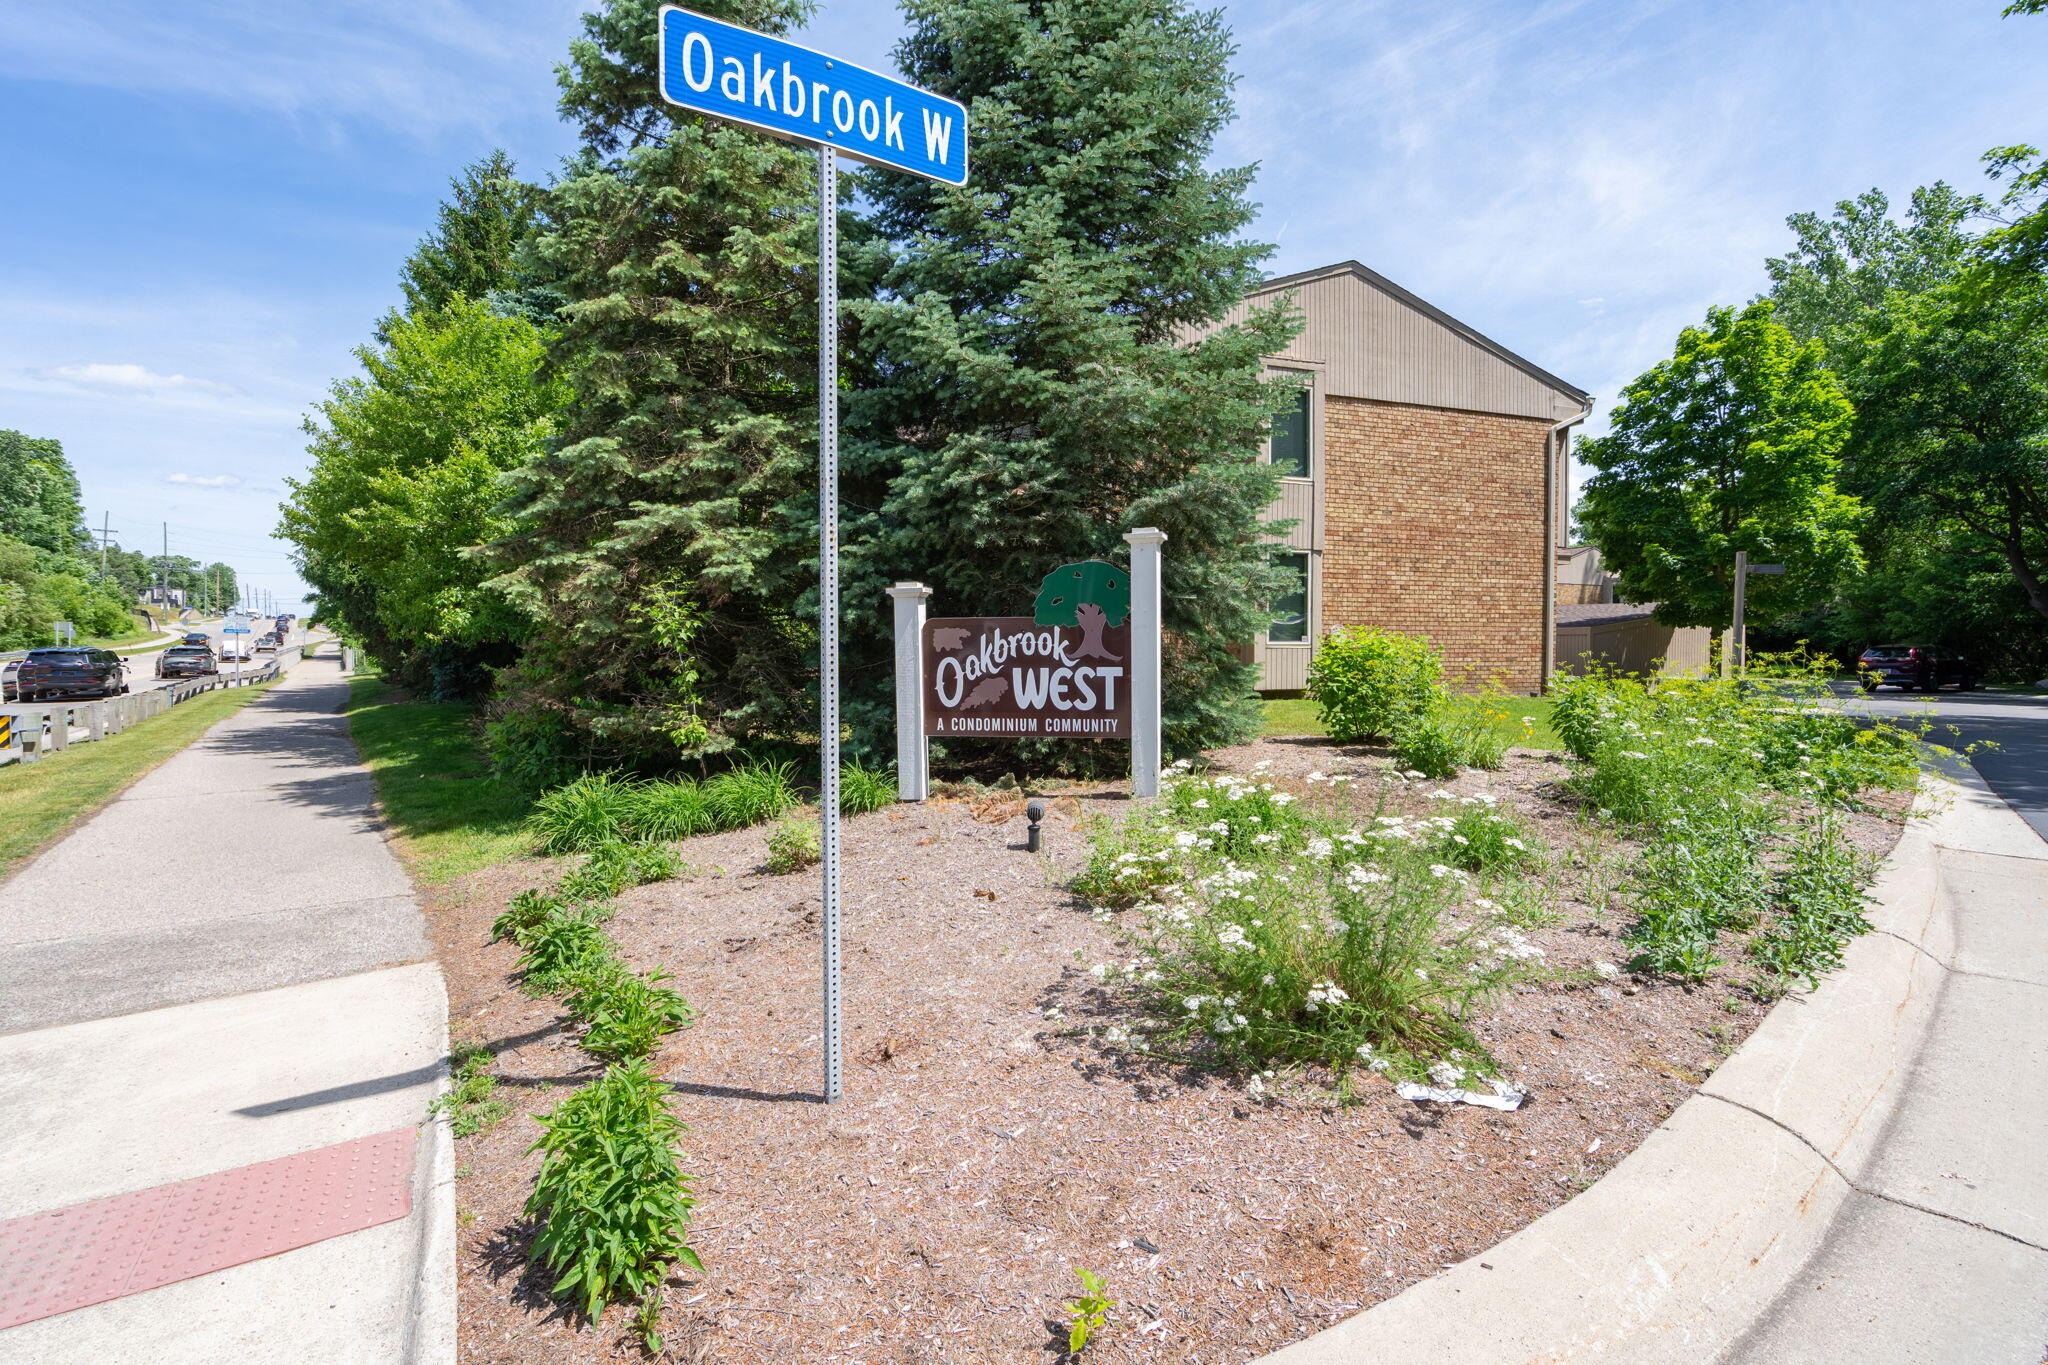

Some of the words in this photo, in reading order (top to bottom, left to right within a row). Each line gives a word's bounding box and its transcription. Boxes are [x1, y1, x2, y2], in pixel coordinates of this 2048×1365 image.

[682, 31, 905, 151] Oakbrook
[922, 107, 952, 165] W
[934, 625, 1080, 708] Oakbrook
[1012, 666, 1124, 711] WEST
[937, 717, 944, 731] A
[951, 717, 1037, 732] CONDOMINIUM
[1045, 718, 1118, 732] COMMUNITY
